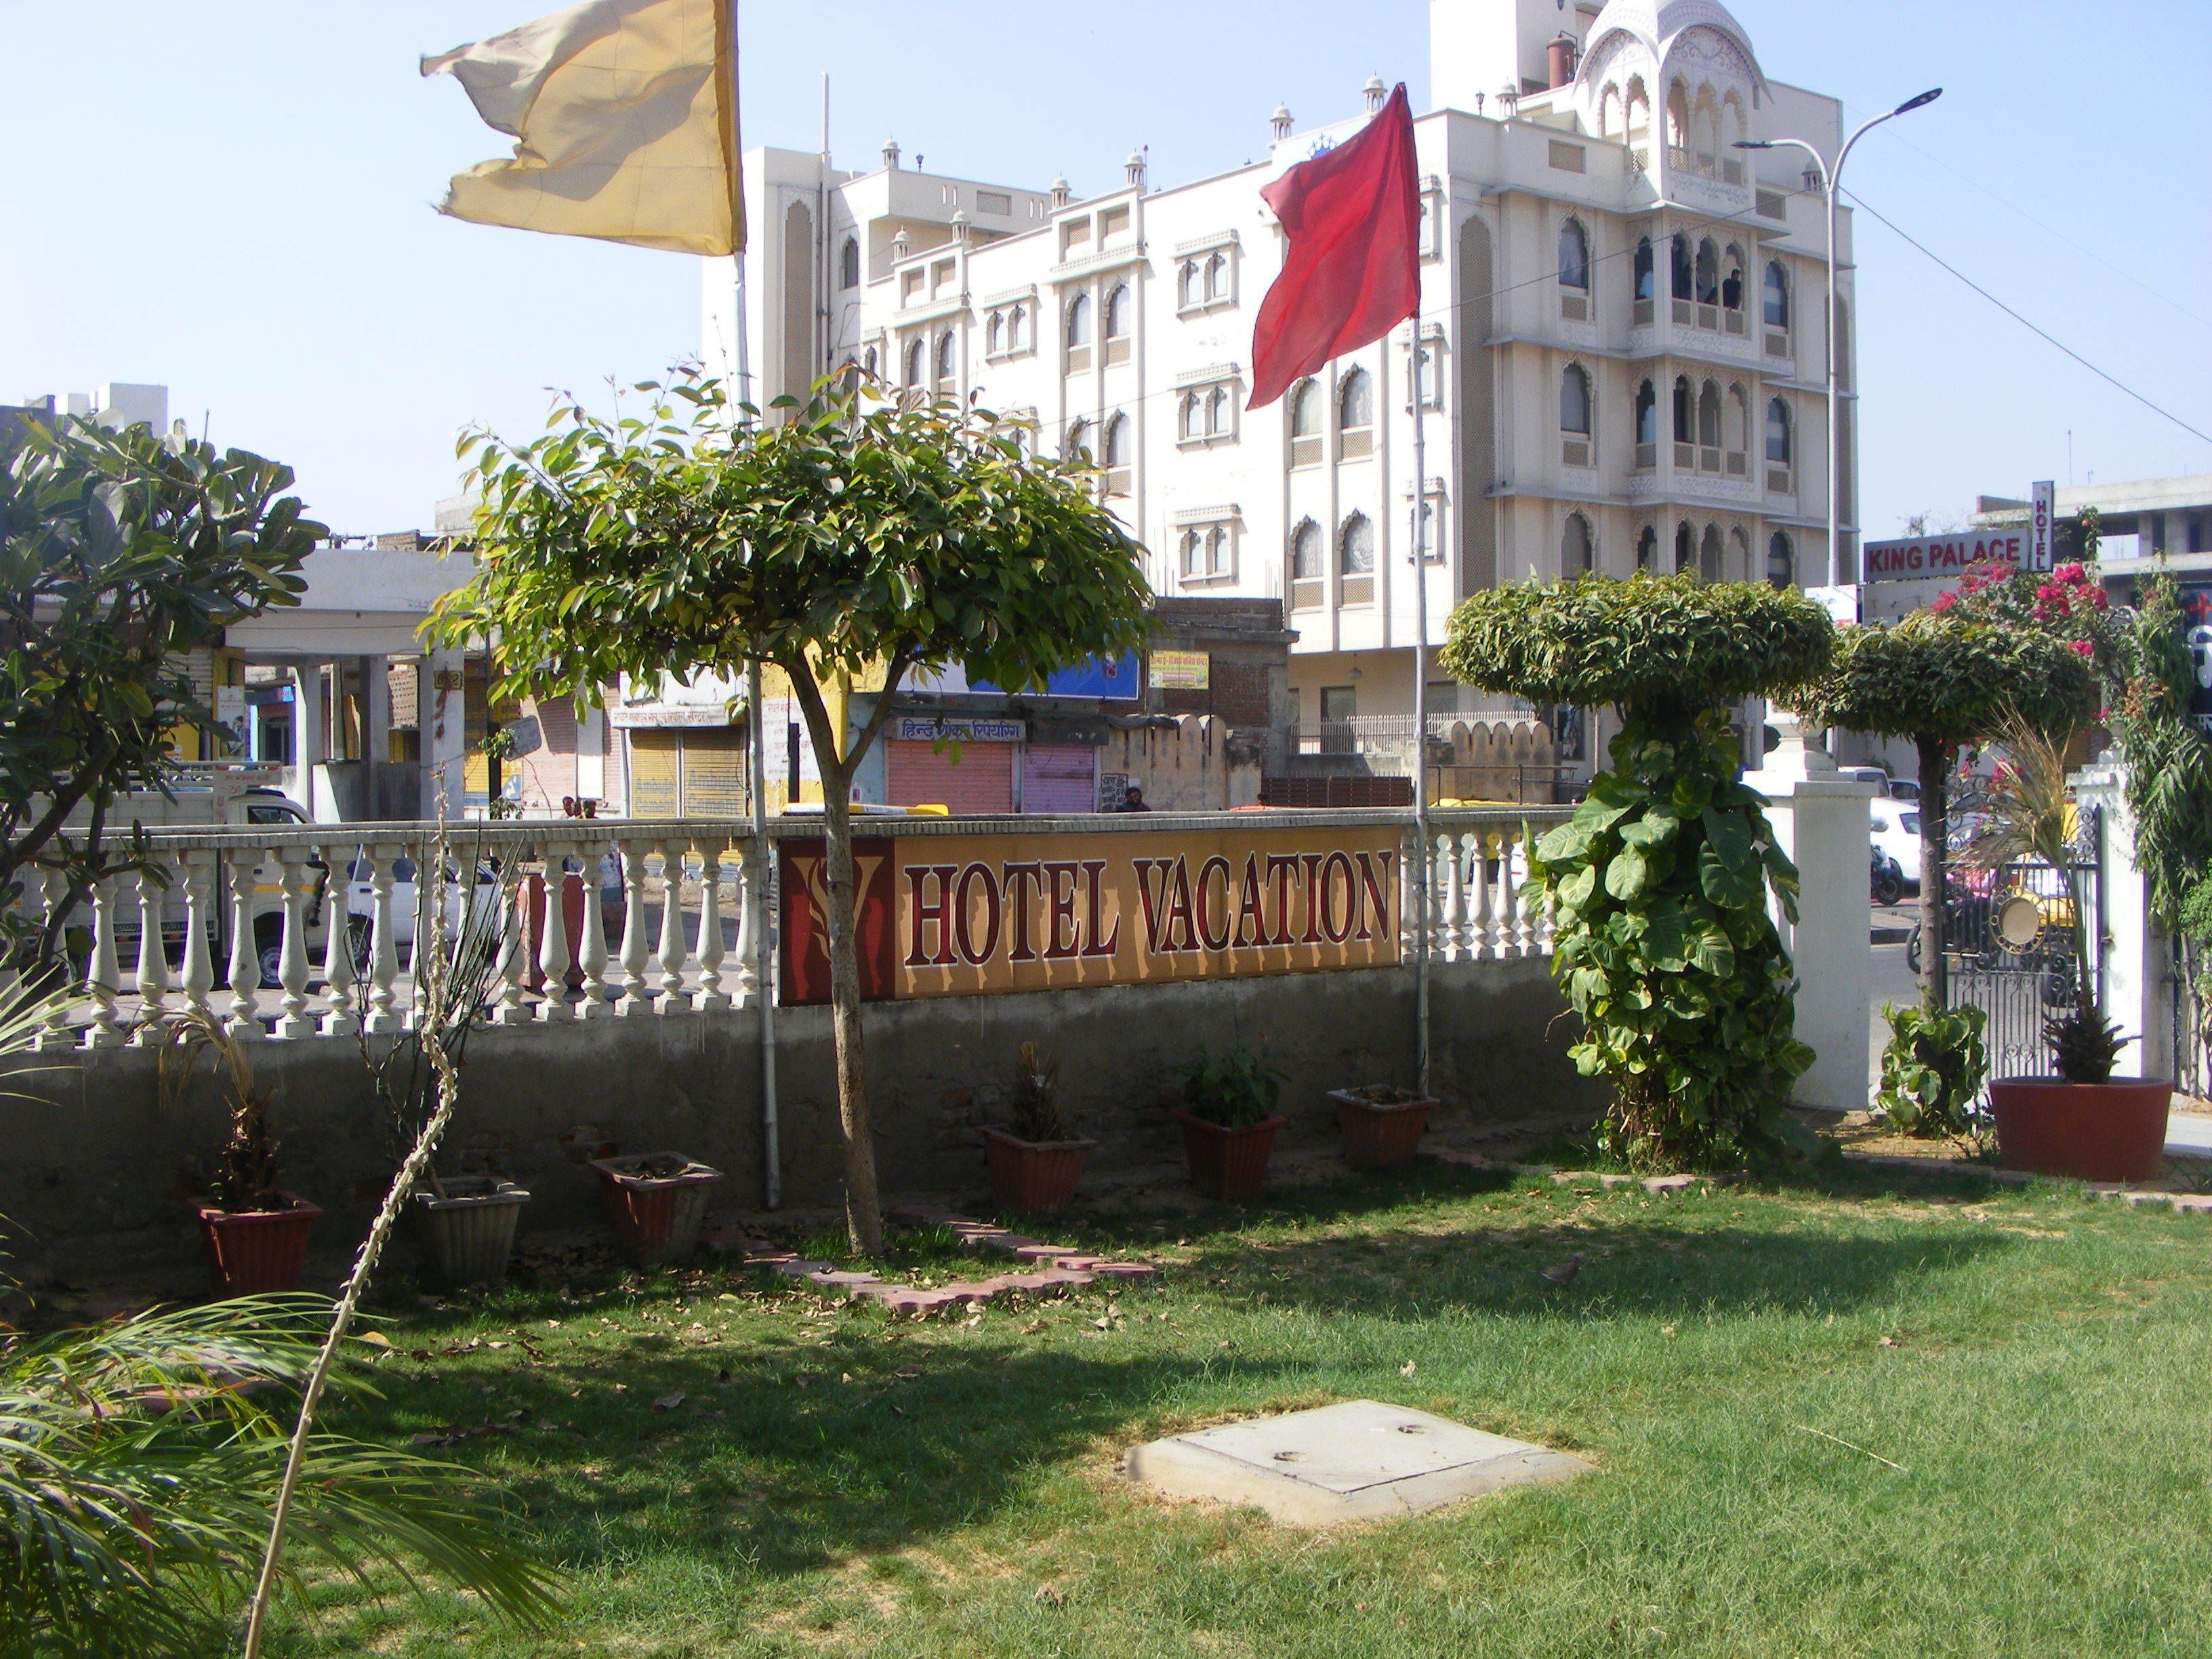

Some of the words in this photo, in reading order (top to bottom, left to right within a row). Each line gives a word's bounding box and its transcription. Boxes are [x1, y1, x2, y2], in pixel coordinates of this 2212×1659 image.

[1868, 546, 1923, 573] KING
[1929, 537, 2020, 567] PALACE
[2035, 499, 2047, 569] HOTEL
[903, 859, 1120, 969] HOTEL
[1131, 849, 1393, 957] VACATION
